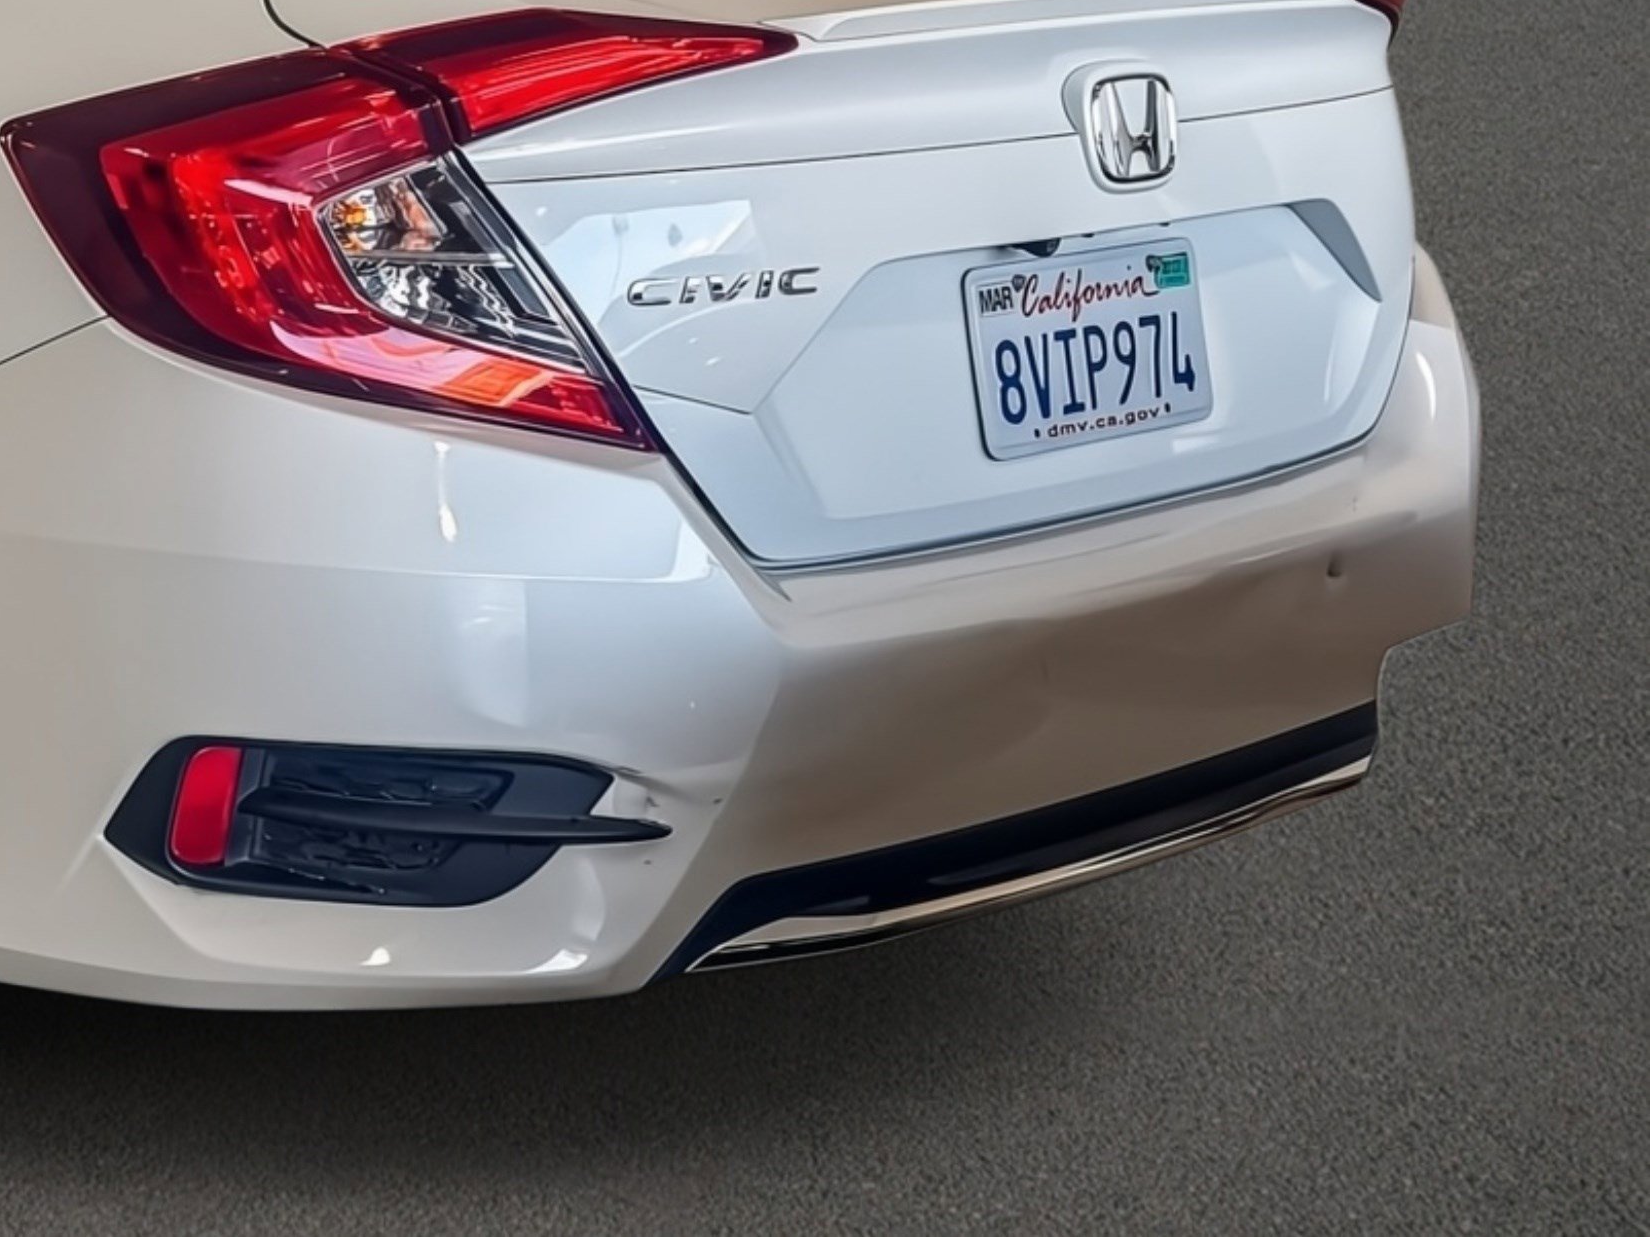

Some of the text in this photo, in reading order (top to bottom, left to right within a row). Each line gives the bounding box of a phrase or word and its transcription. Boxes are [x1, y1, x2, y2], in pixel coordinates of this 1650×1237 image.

[626, 266, 821, 307] CIVIC
[978, 288, 1014, 314] MAR
[1020, 265, 1160, 322] California
[994, 311, 1196, 425] 8VIP974
[1047, 407, 1161, 439] dmv.ca.gov
